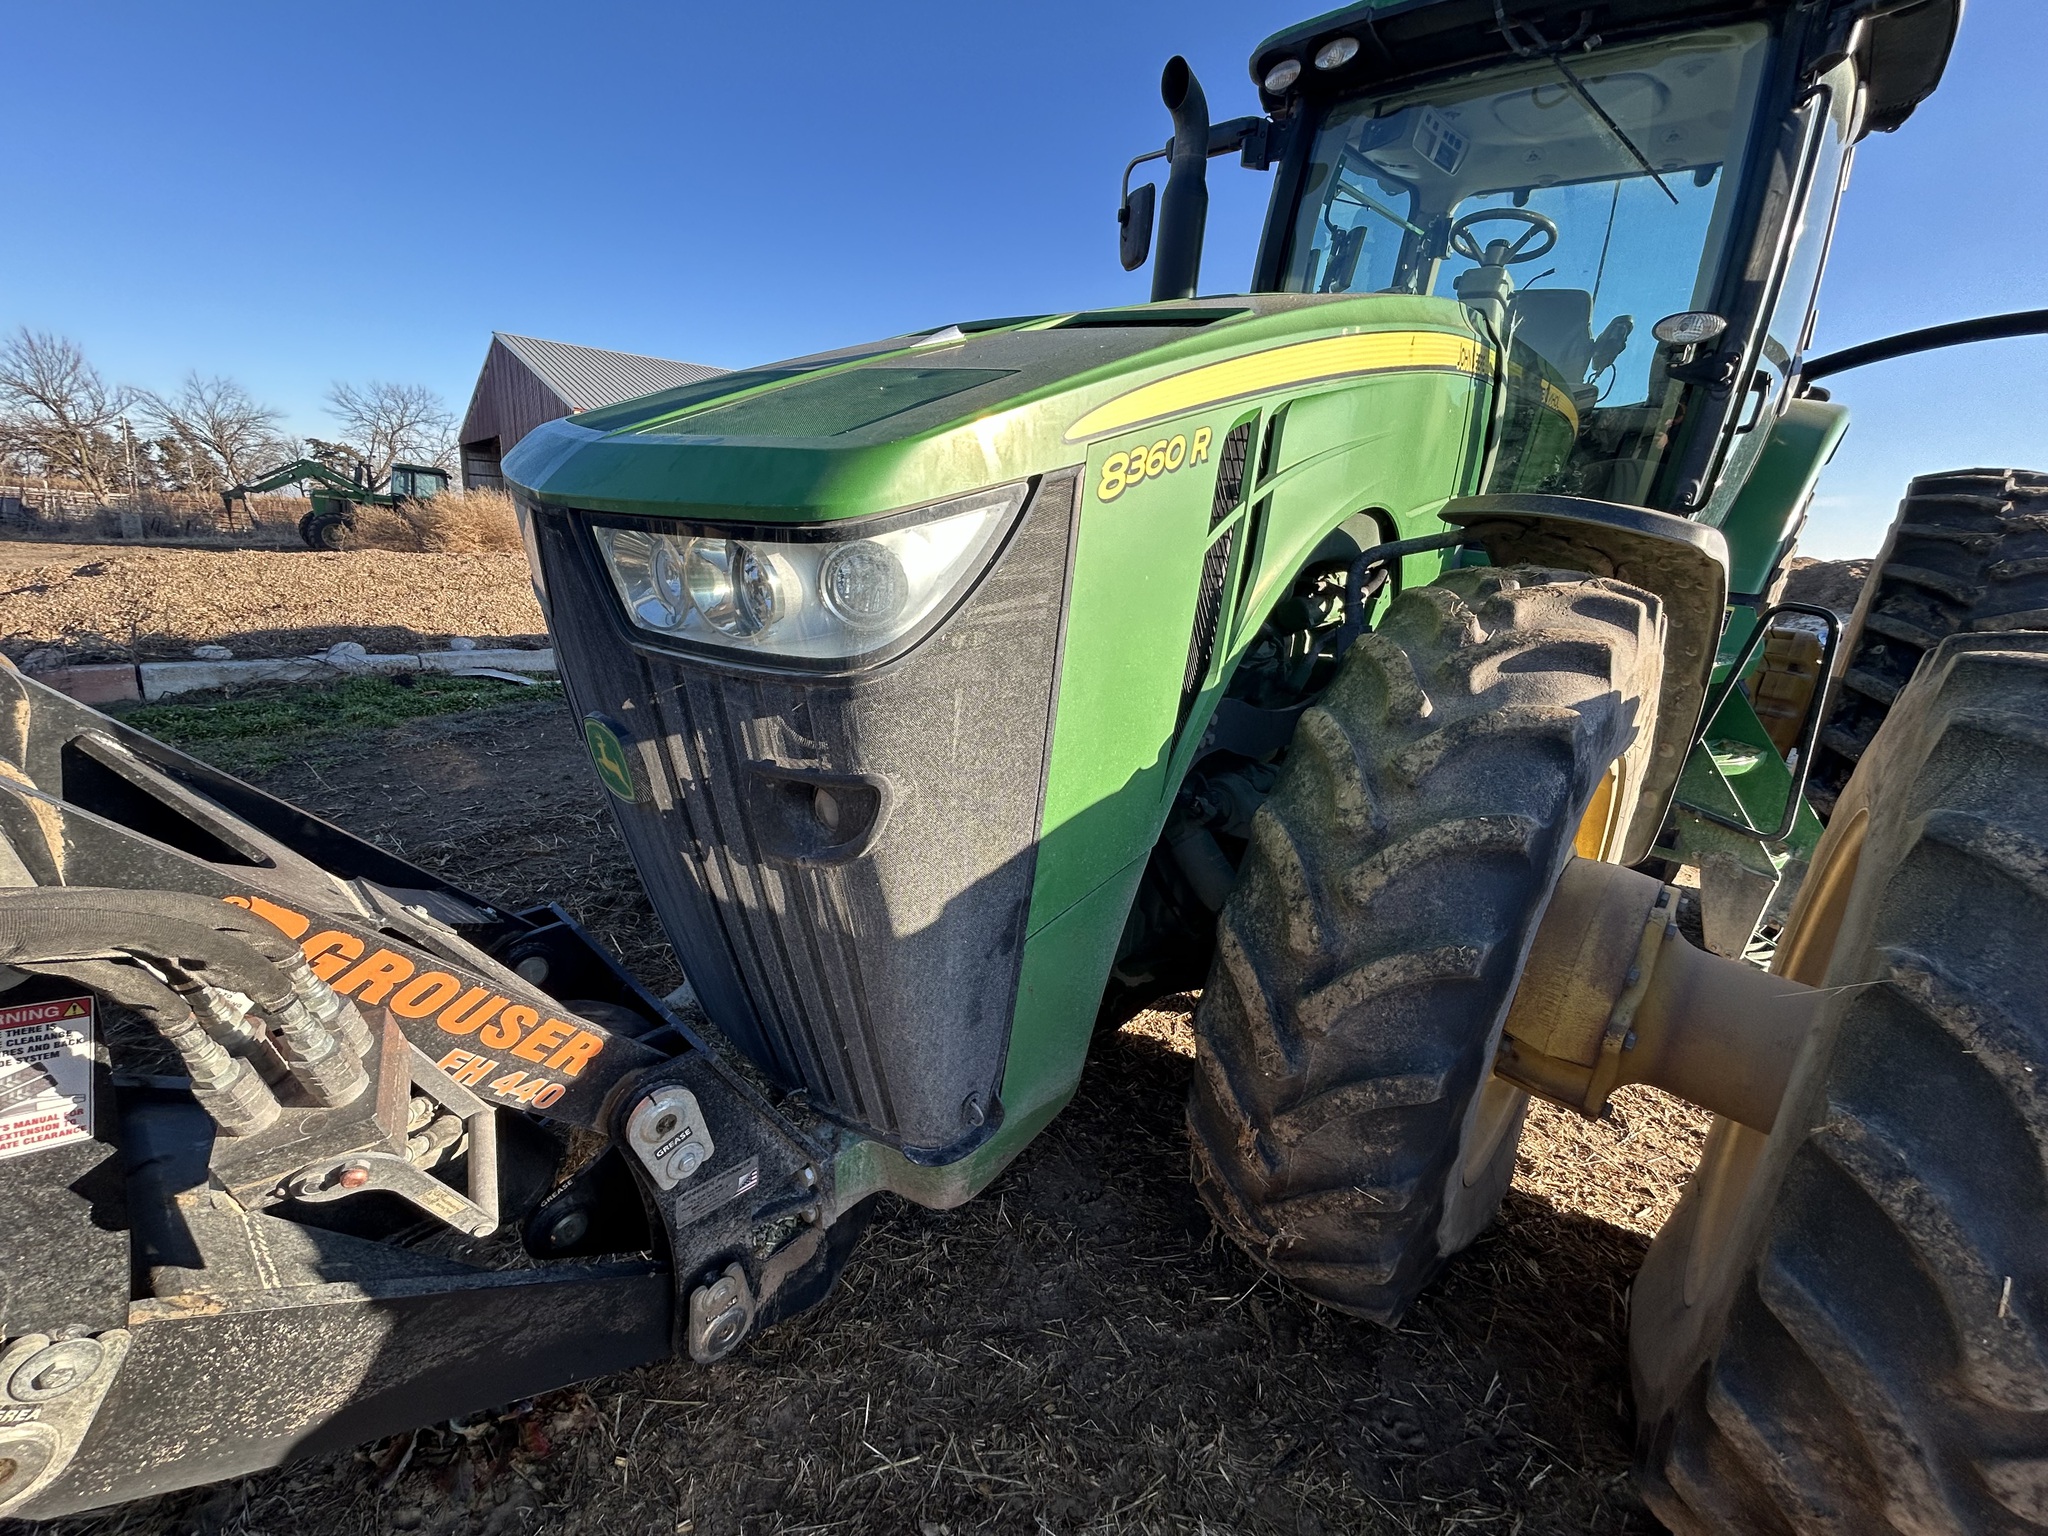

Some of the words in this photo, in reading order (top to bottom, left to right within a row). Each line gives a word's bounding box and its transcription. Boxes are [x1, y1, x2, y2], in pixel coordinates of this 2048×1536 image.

[1097, 433, 1187, 503] 8360
[1189, 425, 1213, 468] R
[301, 930, 604, 1077] GROUSER
[6, 1025, 42, 1038] THERE
[46, 1023, 57, 1031] IS
[6, 1030, 72, 1047] CLEARANCE
[27, 1043, 50, 1054] AND
[54, 1038, 84, 1049] BACK
[16, 1050, 60, 1065] SYSTEM
[488, 1070, 566, 1110] 440
[13, 1114, 60, 1129] MANUAL
[63, 1108, 84, 1119] FOR
[0, 1122, 60, 1141] EXTENSION
[23, 1125, 86, 1145] CLEARANCE
[656, 1128, 692, 1157] GREASE
[540, 1179, 573, 1207] GREASE
